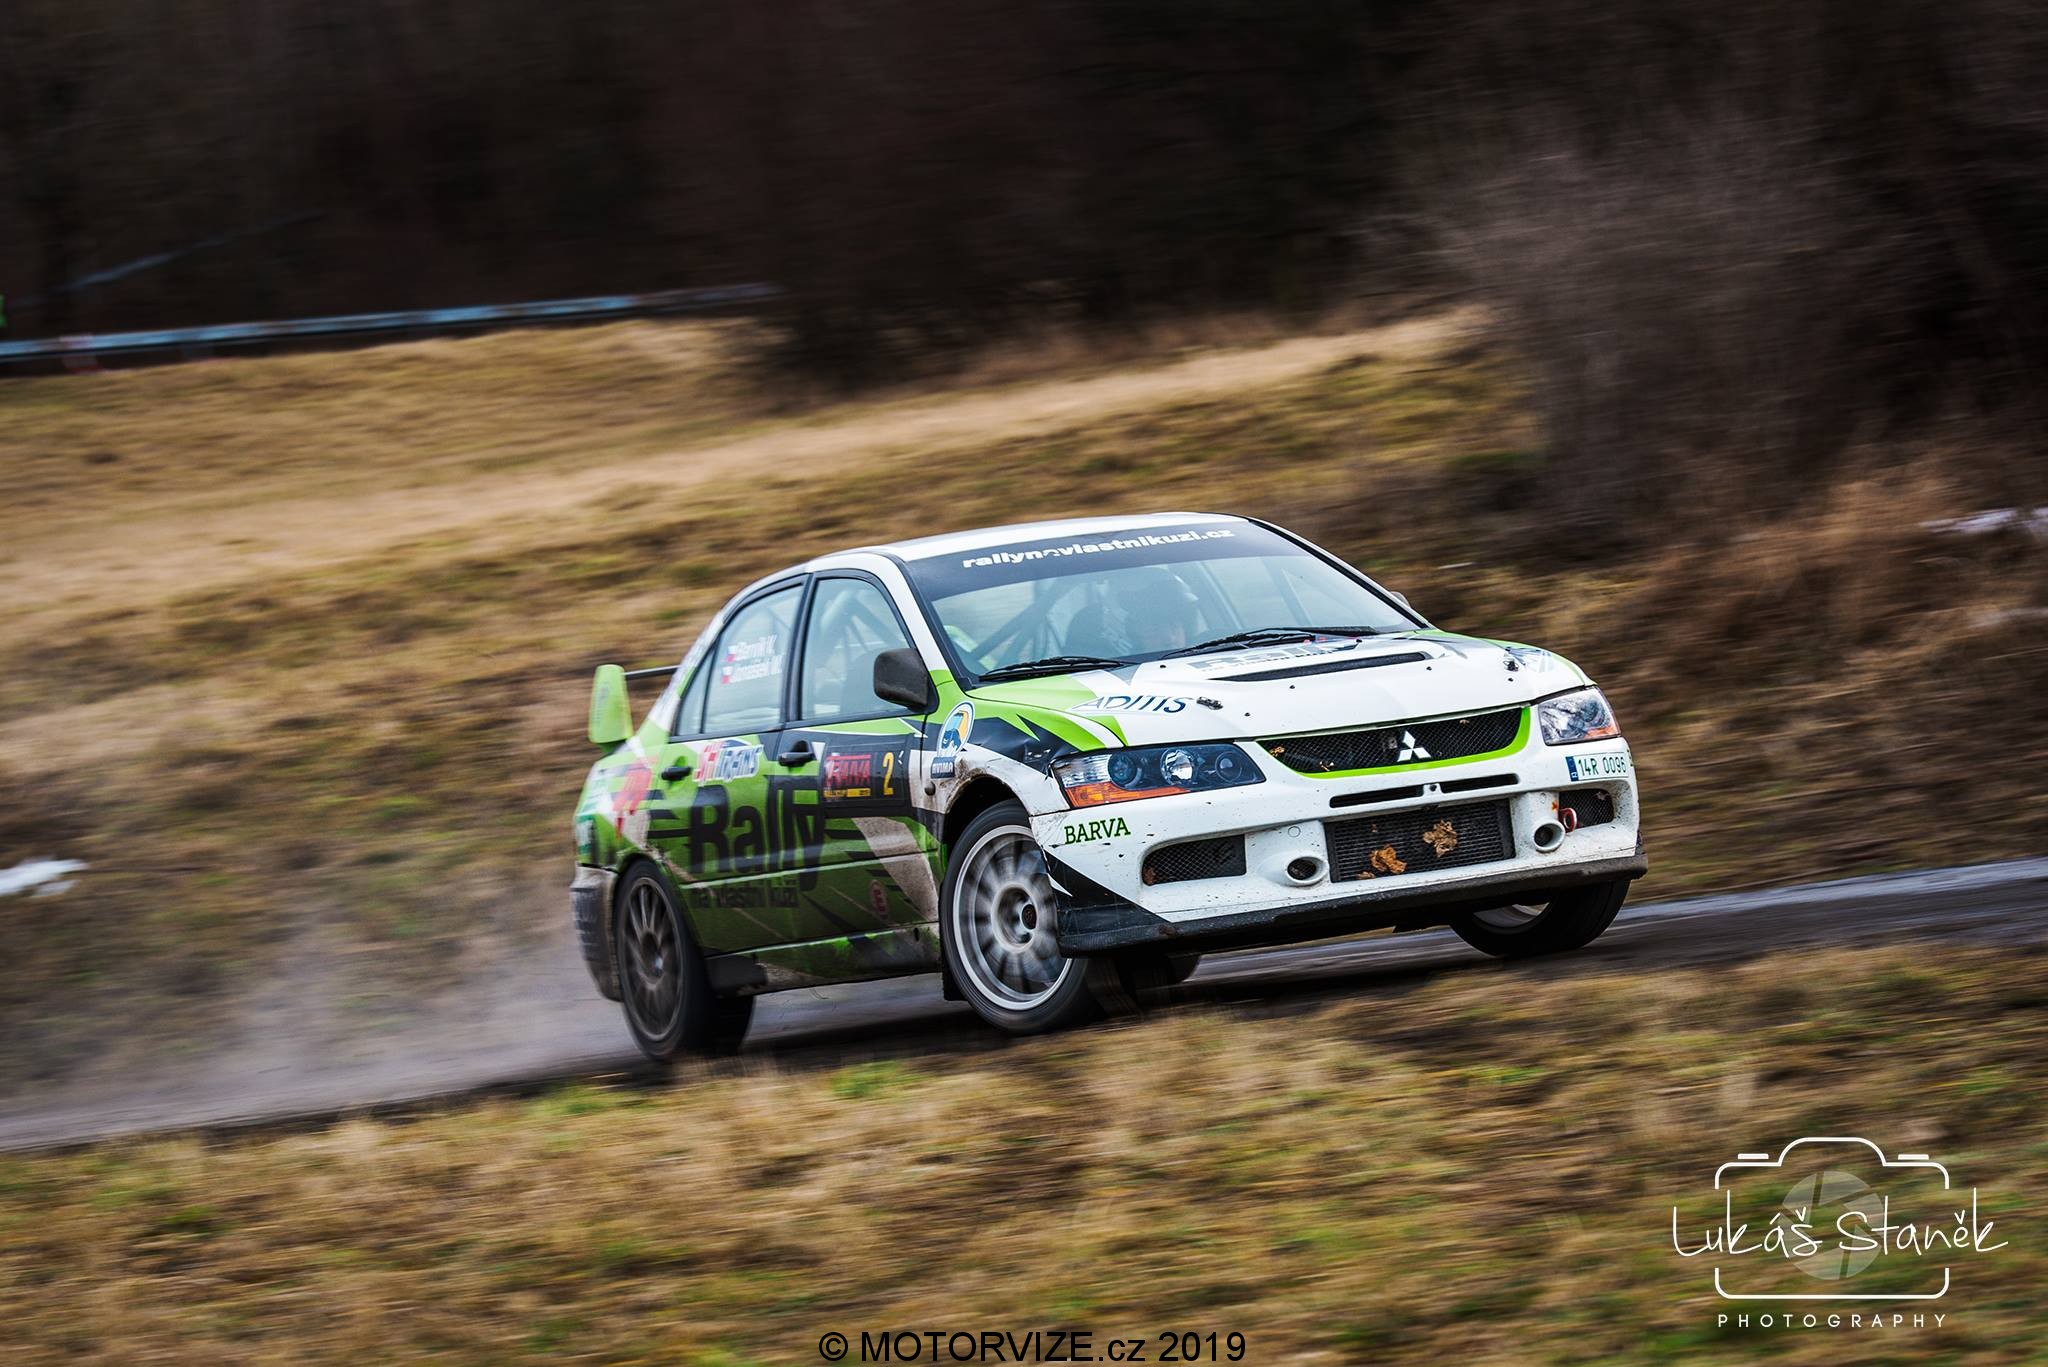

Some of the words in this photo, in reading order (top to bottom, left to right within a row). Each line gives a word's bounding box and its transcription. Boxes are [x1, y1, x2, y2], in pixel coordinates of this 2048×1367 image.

[882, 752, 895, 796] 2
[1578, 757, 1600, 777] 14R
[689, 775, 825, 892] Rally
[1064, 817, 1131, 845] BARVA
